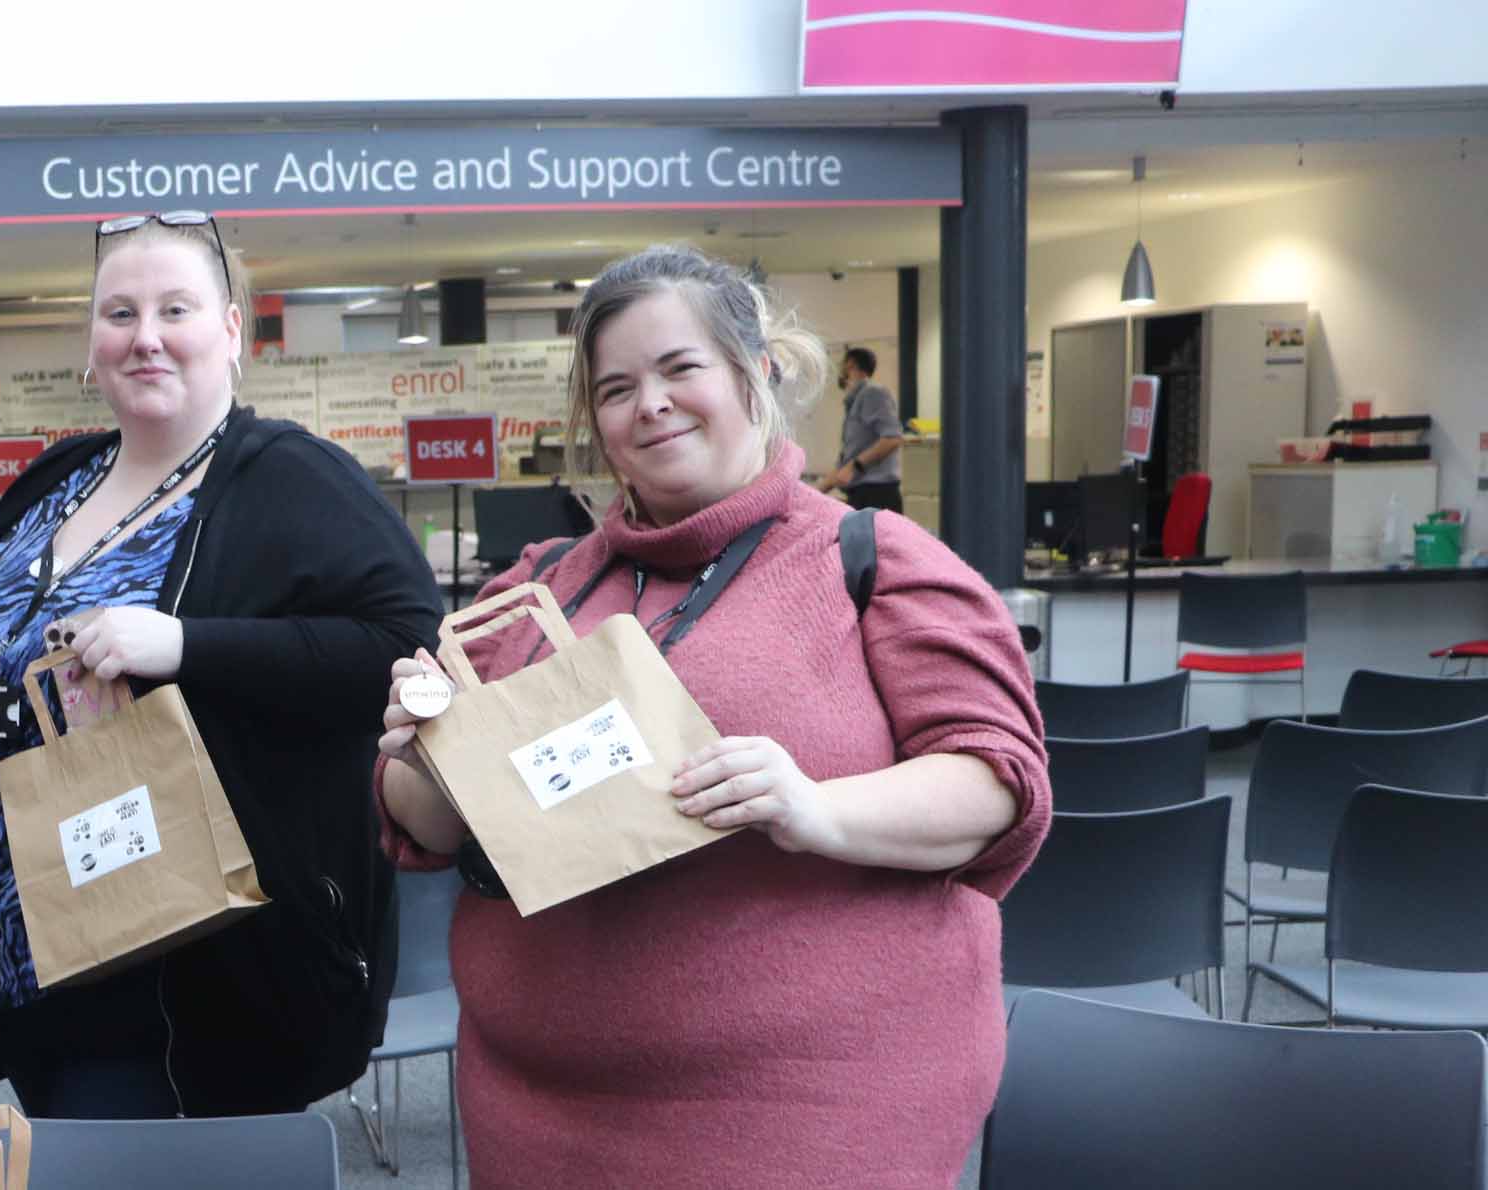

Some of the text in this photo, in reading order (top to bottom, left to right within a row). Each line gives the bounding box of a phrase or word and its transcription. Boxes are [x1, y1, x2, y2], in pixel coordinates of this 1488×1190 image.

[42, 147, 842, 200] Customer Advice and Support Centre
[391, 363, 465, 397] enrol
[417, 440, 468, 459] DESK
[472, 439, 486, 457] 4
